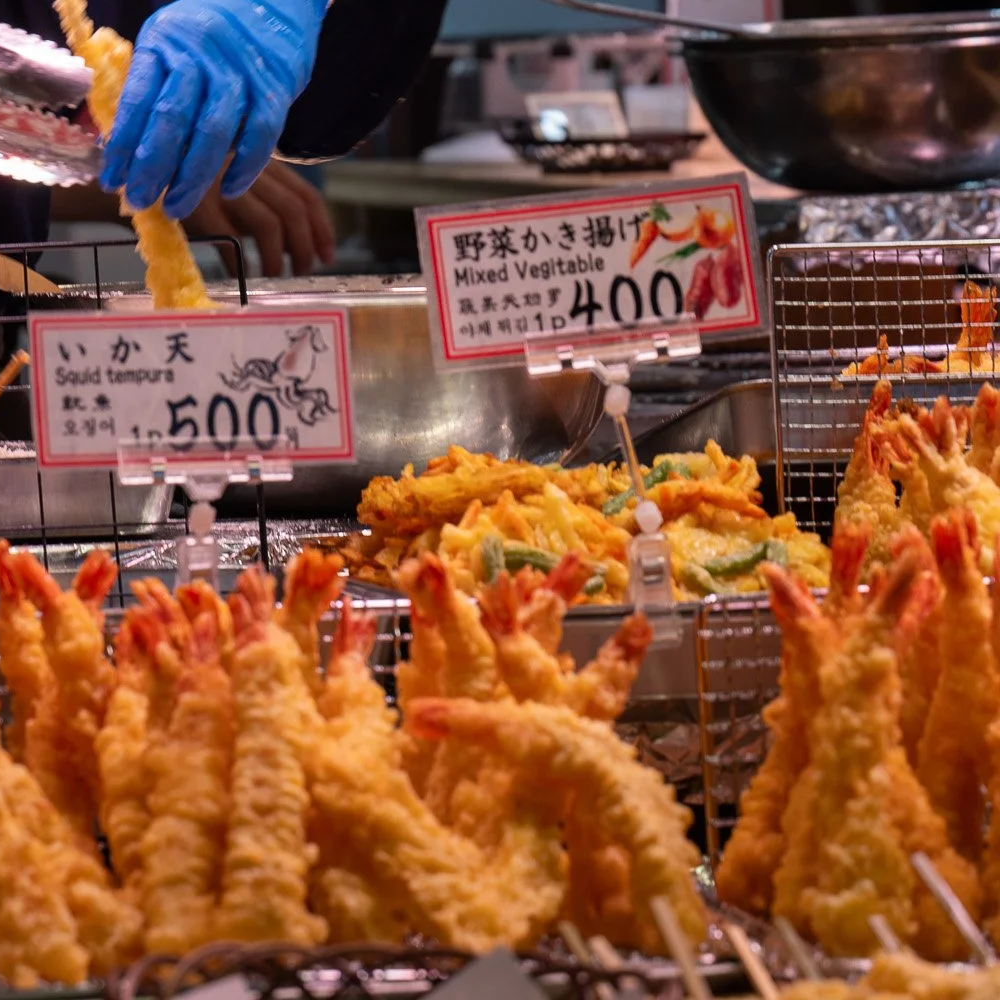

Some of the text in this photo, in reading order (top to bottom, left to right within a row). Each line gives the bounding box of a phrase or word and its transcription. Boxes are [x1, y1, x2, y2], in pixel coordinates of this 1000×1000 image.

[453, 212, 652, 264] 野菜かき揚げ
[455, 264, 509, 288] Mixed
[570, 271, 685, 336] 400
[57, 332, 195, 364] いか天
[55, 365, 102, 388] Squid
[167, 393, 280, 451] 500
